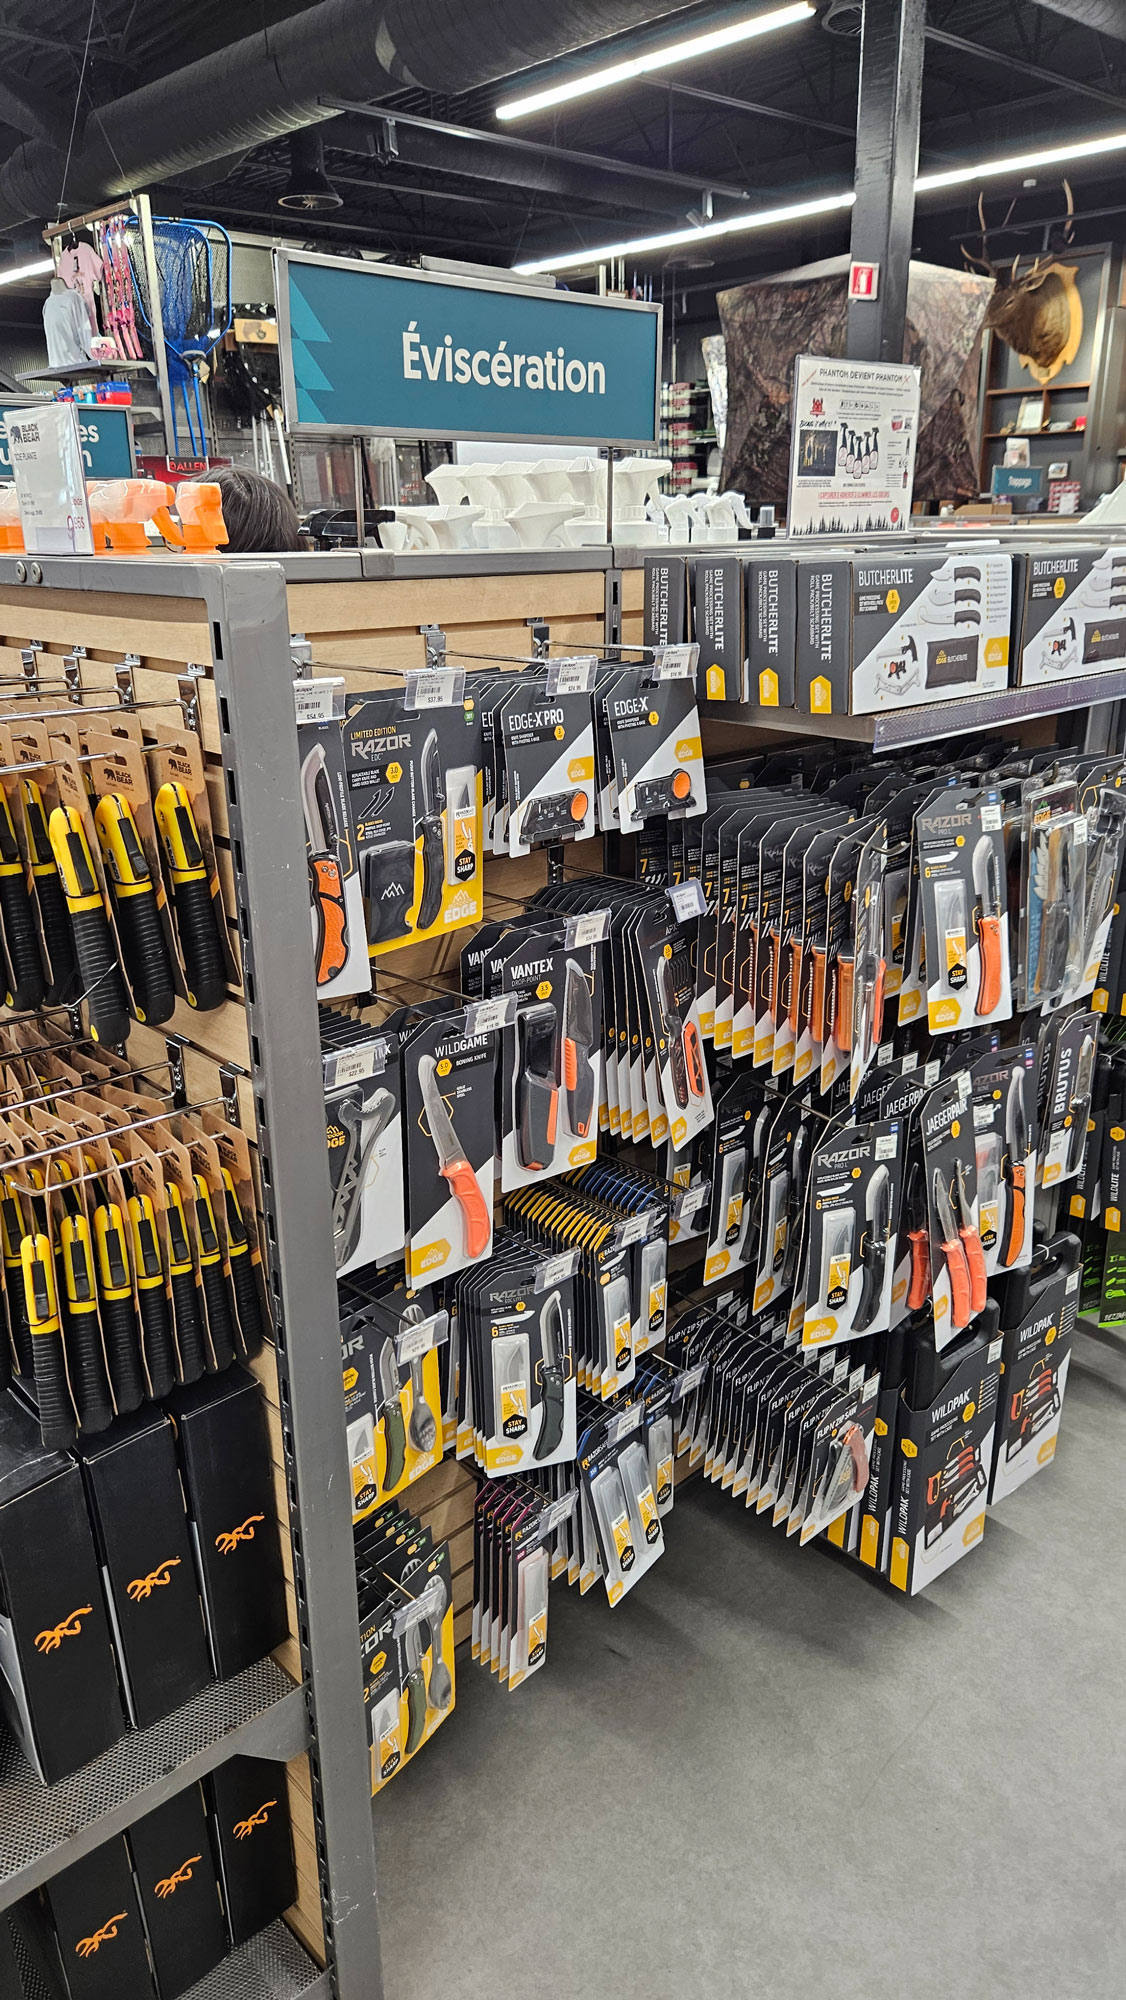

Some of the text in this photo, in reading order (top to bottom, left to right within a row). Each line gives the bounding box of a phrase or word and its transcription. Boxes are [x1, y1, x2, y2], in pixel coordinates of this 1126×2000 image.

[402, 320, 606, 395] Éviscération
[820, 368, 903, 383] PHANTOM DEVIENT PHANTOM
[22, 424, 38, 432] BLACK
[23, 432, 40, 443] BEAR
[175, 461, 207, 472] ALLEN
[1034, 559, 1079, 576] BUTCHERLITE
[859, 569, 914, 586] BUTCHERLITE
[714, 569, 724, 651] BUTCHERLITE
[768, 570, 779, 654] BUTCHERLITE
[821, 574, 832, 661] BUTCHERLITE
[614, 697, 649, 716] EDGE-X
[509, 708, 564, 731] EDGE-X PRO
[350, 726, 396, 740] LIMITED EDITION
[351, 734, 412, 759] RAZOR
[177, 760, 191, 769] BLACK
[371, 753, 381, 761] EDC
[116, 770, 131, 779] BLACK
[178, 765, 192, 776] BEAR
[116, 776, 133, 785] BEAR
[921, 814, 972, 833] RAZOR
[357, 824, 365, 841] 2
[457, 863, 473, 873] SHARP
[459, 855, 471, 866] STAY
[640, 858, 648, 873] 7
[925, 866, 931, 878] 6
[704, 882, 713, 898] 7
[722, 888, 730, 904] 7
[740, 894, 748, 910] 7
[444, 901, 477, 924] EDGE
[511, 958, 553, 980] VANTEX
[512, 975, 541, 987] DROP-POINT
[950, 974, 966, 983] SHARP
[935, 1012, 955, 1023] EDGE
[435, 1037, 488, 1058] WILDGAME
[456, 1053, 487, 1066] BONING KNIFE
[973, 1069, 1009, 1085] AZOR
[1053, 1048, 1072, 1114] BRUTUS
[926, 1097, 968, 1136] JAEGERPAIR
[817, 1146, 870, 1168] RAZOR
[1110, 1173, 1119, 1201] WILDLITE
[816, 1199, 822, 1210] 6
[420, 1251, 444, 1268] EDGE
[490, 1286, 534, 1302] RAZOR
[829, 1296, 845, 1305] SHARP
[831, 1290, 843, 1298] STAY
[491, 1326, 499, 1337] 6
[668, 1322, 696, 1344] FLIP ZIP
[810, 1328, 831, 1340] EDGE
[1019, 1313, 1055, 1343] WILDPAK
[746, 1383, 760, 1394] FLIP
[771, 1387, 800, 1410] FLIP ZIP
[931, 1387, 973, 1423] WILDPAK
[788, 1409, 800, 1420] FLIP
[817, 1405, 857, 1440] FLIP ZIP SAW
[505, 1424, 525, 1434] SHARP
[507, 1418, 523, 1428] STAY
[803, 1418, 815, 1430] FLIP
[930, 1416, 958, 1437] GAME PROCESSING
[409, 1455, 436, 1480] EDGE
[495, 1454, 517, 1465] EDGE
[357, 1492, 377, 1508] SHARP
[359, 1486, 374, 1500] STAY
[868, 1473, 879, 1512] WILDPAK
[898, 1496, 909, 1535] WILDPAK
[361, 1625, 376, 1642] TION
[382, 1760, 399, 1776] SHARP
